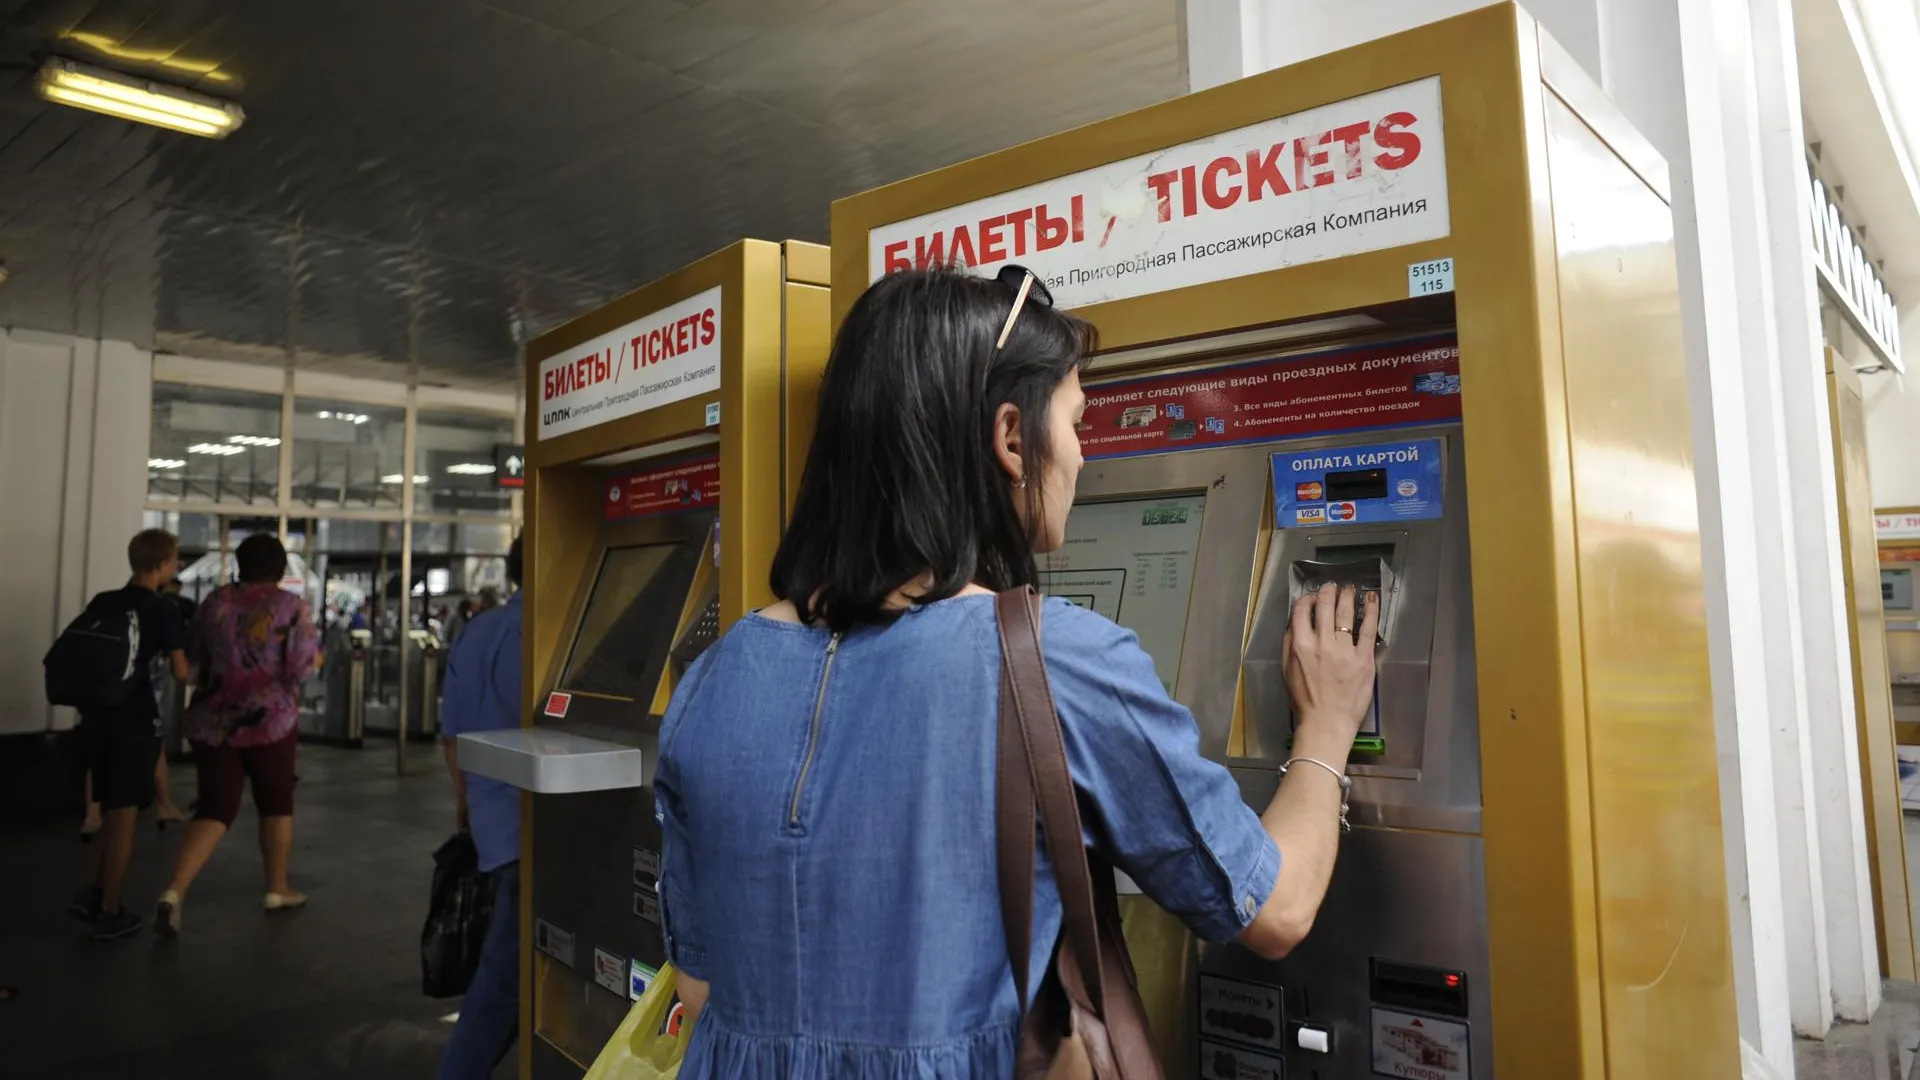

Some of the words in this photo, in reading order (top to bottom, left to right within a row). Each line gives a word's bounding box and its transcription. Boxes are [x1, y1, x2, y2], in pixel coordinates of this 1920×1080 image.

[884, 194, 1085, 275] БИЛЕТЫ
[1147, 111, 1422, 224] TICKETS
[1069, 250, 1176, 287] Пригородная
[1182, 221, 1316, 261] Пассажирская
[1323, 199, 1427, 232] Компания
[1412, 261, 1450, 277] 51513
[1421, 279, 1443, 291] 115
[544, 348, 611, 401] БИЛЕТЫ
[615, 341, 626, 384] /
[631, 308, 716, 370] TICKETS
[640, 375, 682, 397] Пассажирская
[683, 364, 716, 383] Компания
[1147, 380, 1226, 398] следующие
[1230, 374, 1268, 388] виды
[1272, 362, 1357, 382] проездных
[1362, 348, 1459, 371] документов
[1233, 404, 1243, 413] 3.
[1244, 402, 1261, 411] Все
[1263, 399, 1288, 409] виды
[1290, 391, 1362, 405] абонементных
[1365, 384, 1408, 395] билетов
[1233, 420, 1243, 428] 4.
[1244, 413, 1302, 427] Абонементы
[1304, 411, 1316, 419] на
[1319, 405, 1376, 418] количество
[1378, 400, 1421, 412] поездок
[1089, 437, 1099, 445] по
[1100, 431, 1142, 443] социальной
[1143, 430, 1165, 440] карте
[1292, 455, 1353, 472] ОПЛАТА
[1356, 446, 1419, 466] КАРТОЙ
[1301, 509, 1320, 518] VISA
[1394, 1060, 1446, 1080] Купюры
